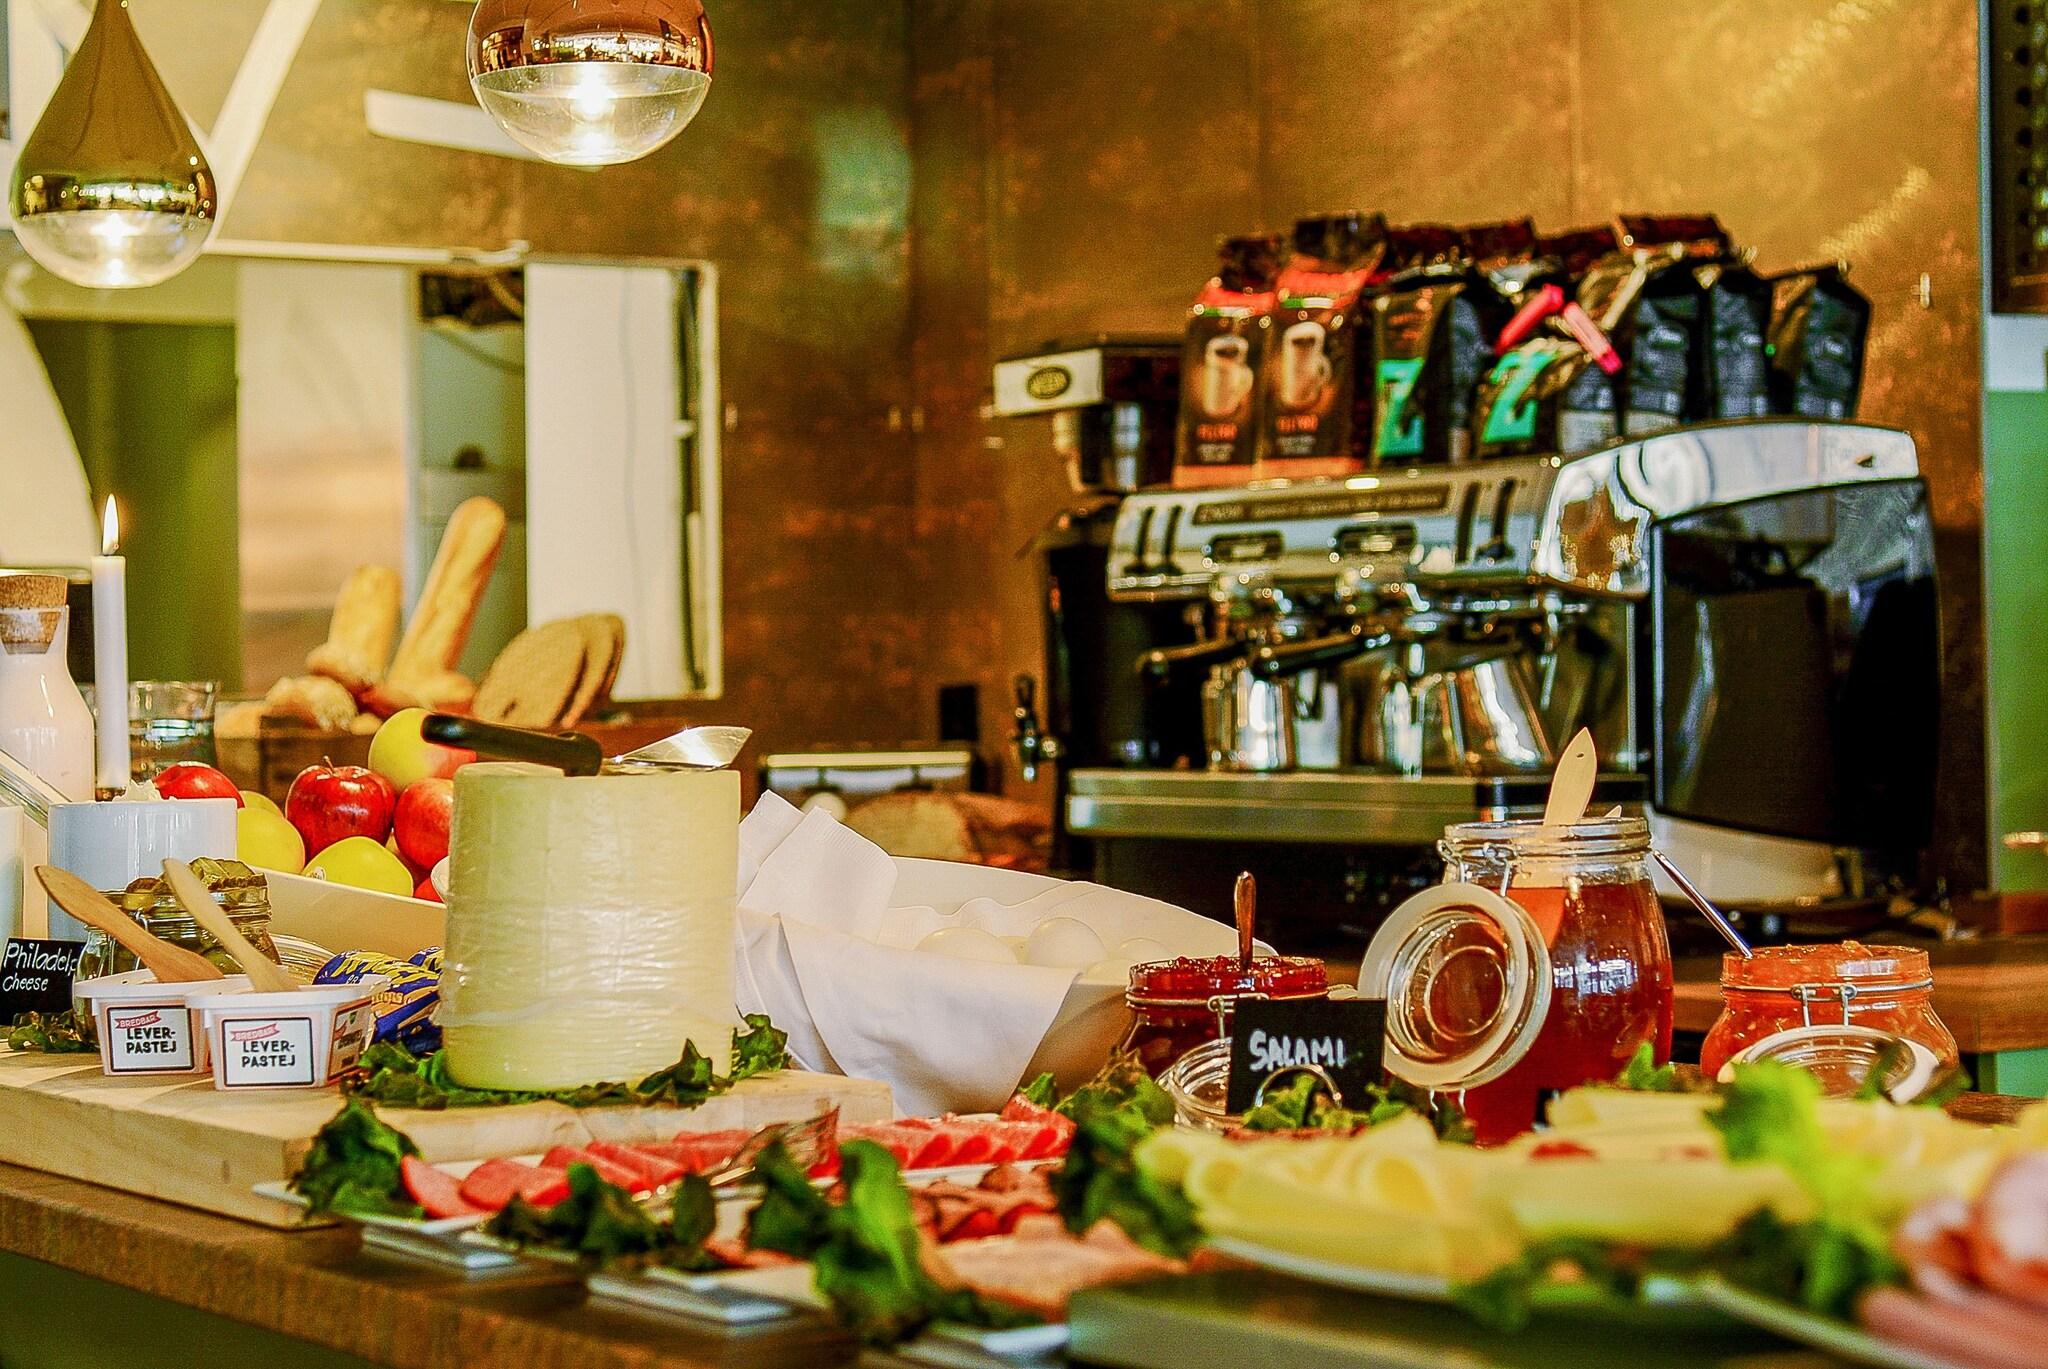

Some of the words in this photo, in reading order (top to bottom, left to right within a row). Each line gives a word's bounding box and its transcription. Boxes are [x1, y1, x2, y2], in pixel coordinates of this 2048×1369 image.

[2, 972, 49, 992] Cheese
[126, 1027, 176, 1040] LEVER-
[126, 1040, 177, 1054] PASTEJ
[242, 1040, 296, 1053] LEVER-
[1250, 1028, 1347, 1072] SALAMI
[241, 1054, 296, 1068] PASTEJ
